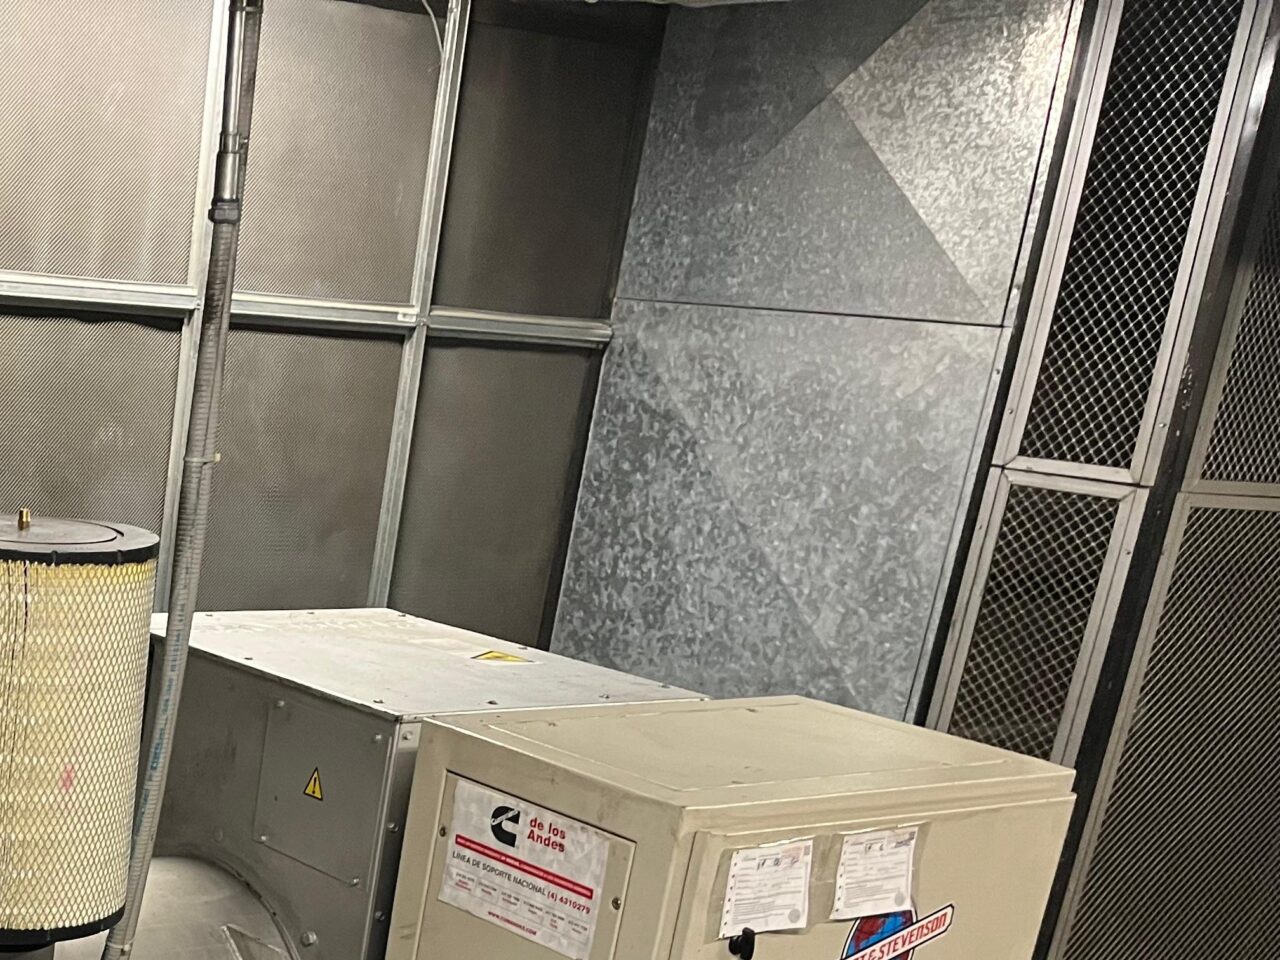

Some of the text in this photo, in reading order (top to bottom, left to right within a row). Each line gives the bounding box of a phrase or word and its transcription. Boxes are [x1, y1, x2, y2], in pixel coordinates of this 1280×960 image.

[527, 829, 565, 853] Andes
[529, 816, 544, 831] de
[548, 822, 566, 840] los
[472, 858, 482, 868] DE
[482, 862, 512, 882] SOPORTE
[512, 875, 546, 896] NACIONAL
[547, 889, 558, 903] (4)
[878, 911, 948, 960] STEVENSON
